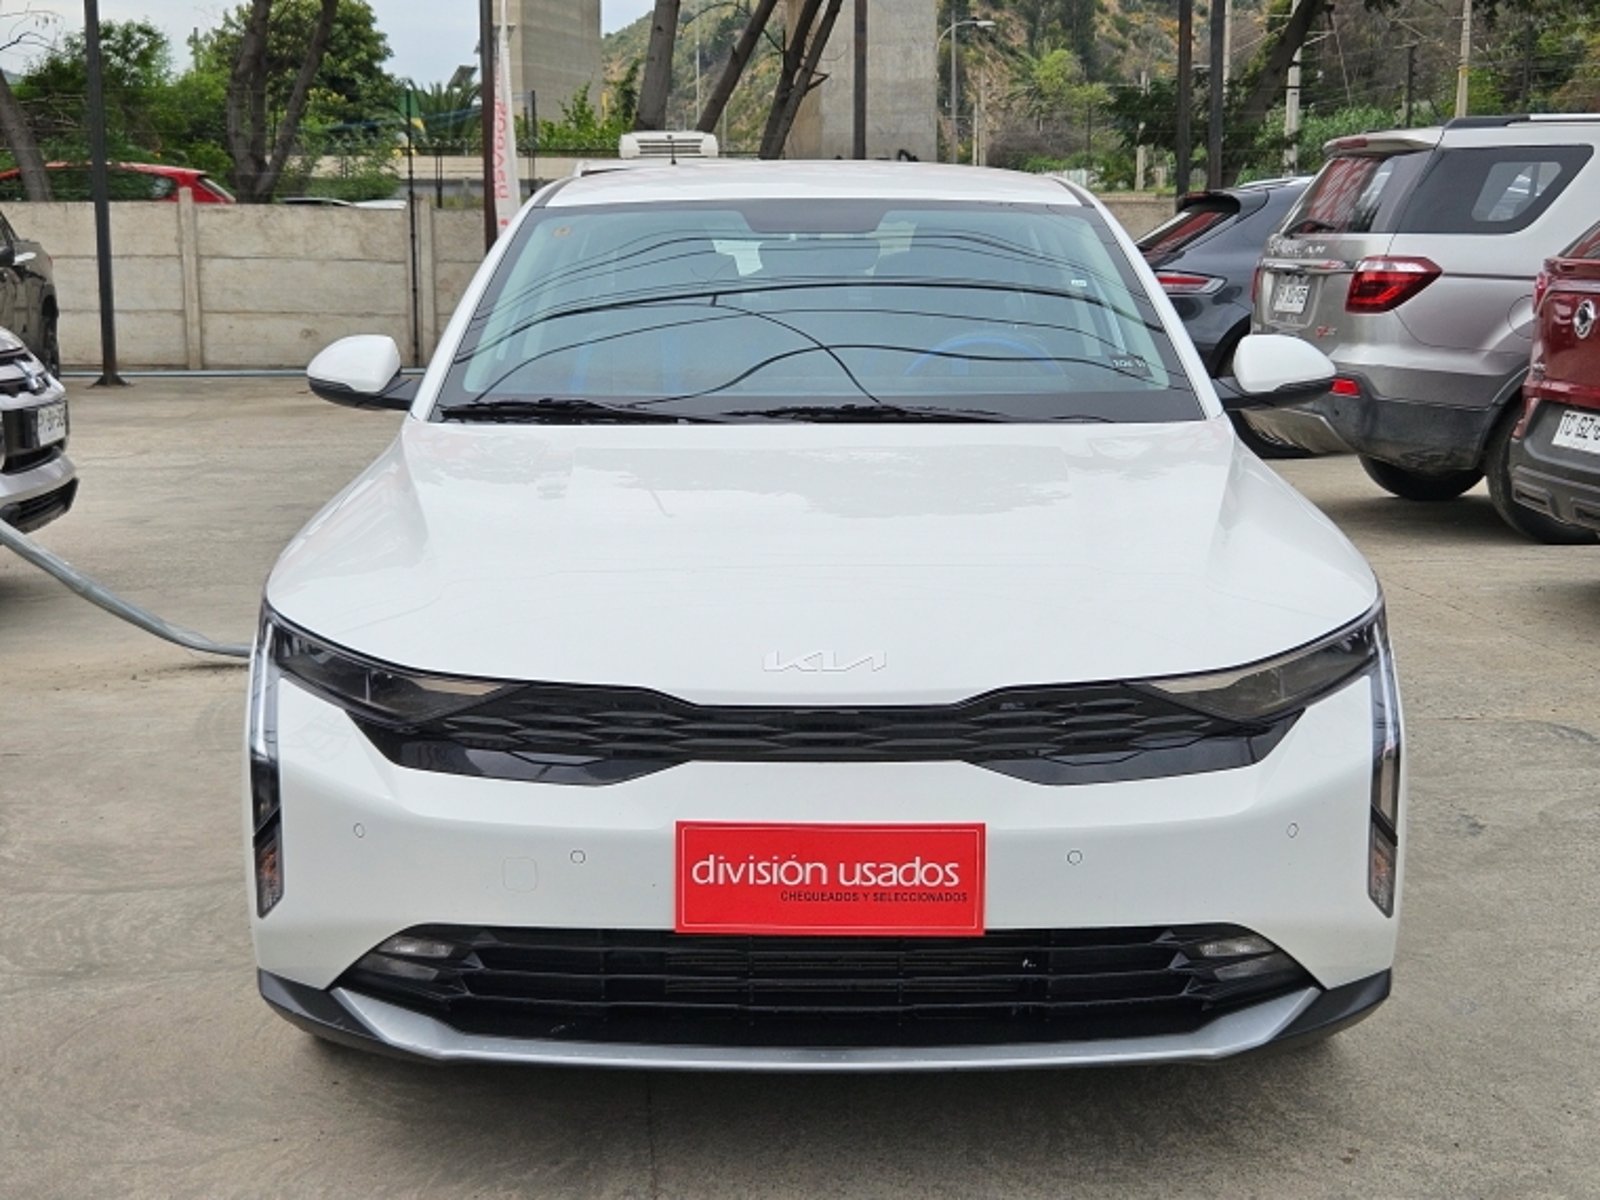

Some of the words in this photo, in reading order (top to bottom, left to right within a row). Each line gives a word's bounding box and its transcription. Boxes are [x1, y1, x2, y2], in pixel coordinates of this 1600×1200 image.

[762, 650, 886, 672] KIA
[691, 854, 828, 886] división
[839, 856, 960, 887] usados
[780, 890, 860, 902] CHEQUEADOS
[863, 891, 870, 902] Y
[873, 891, 968, 903] SELECCIONADOS
